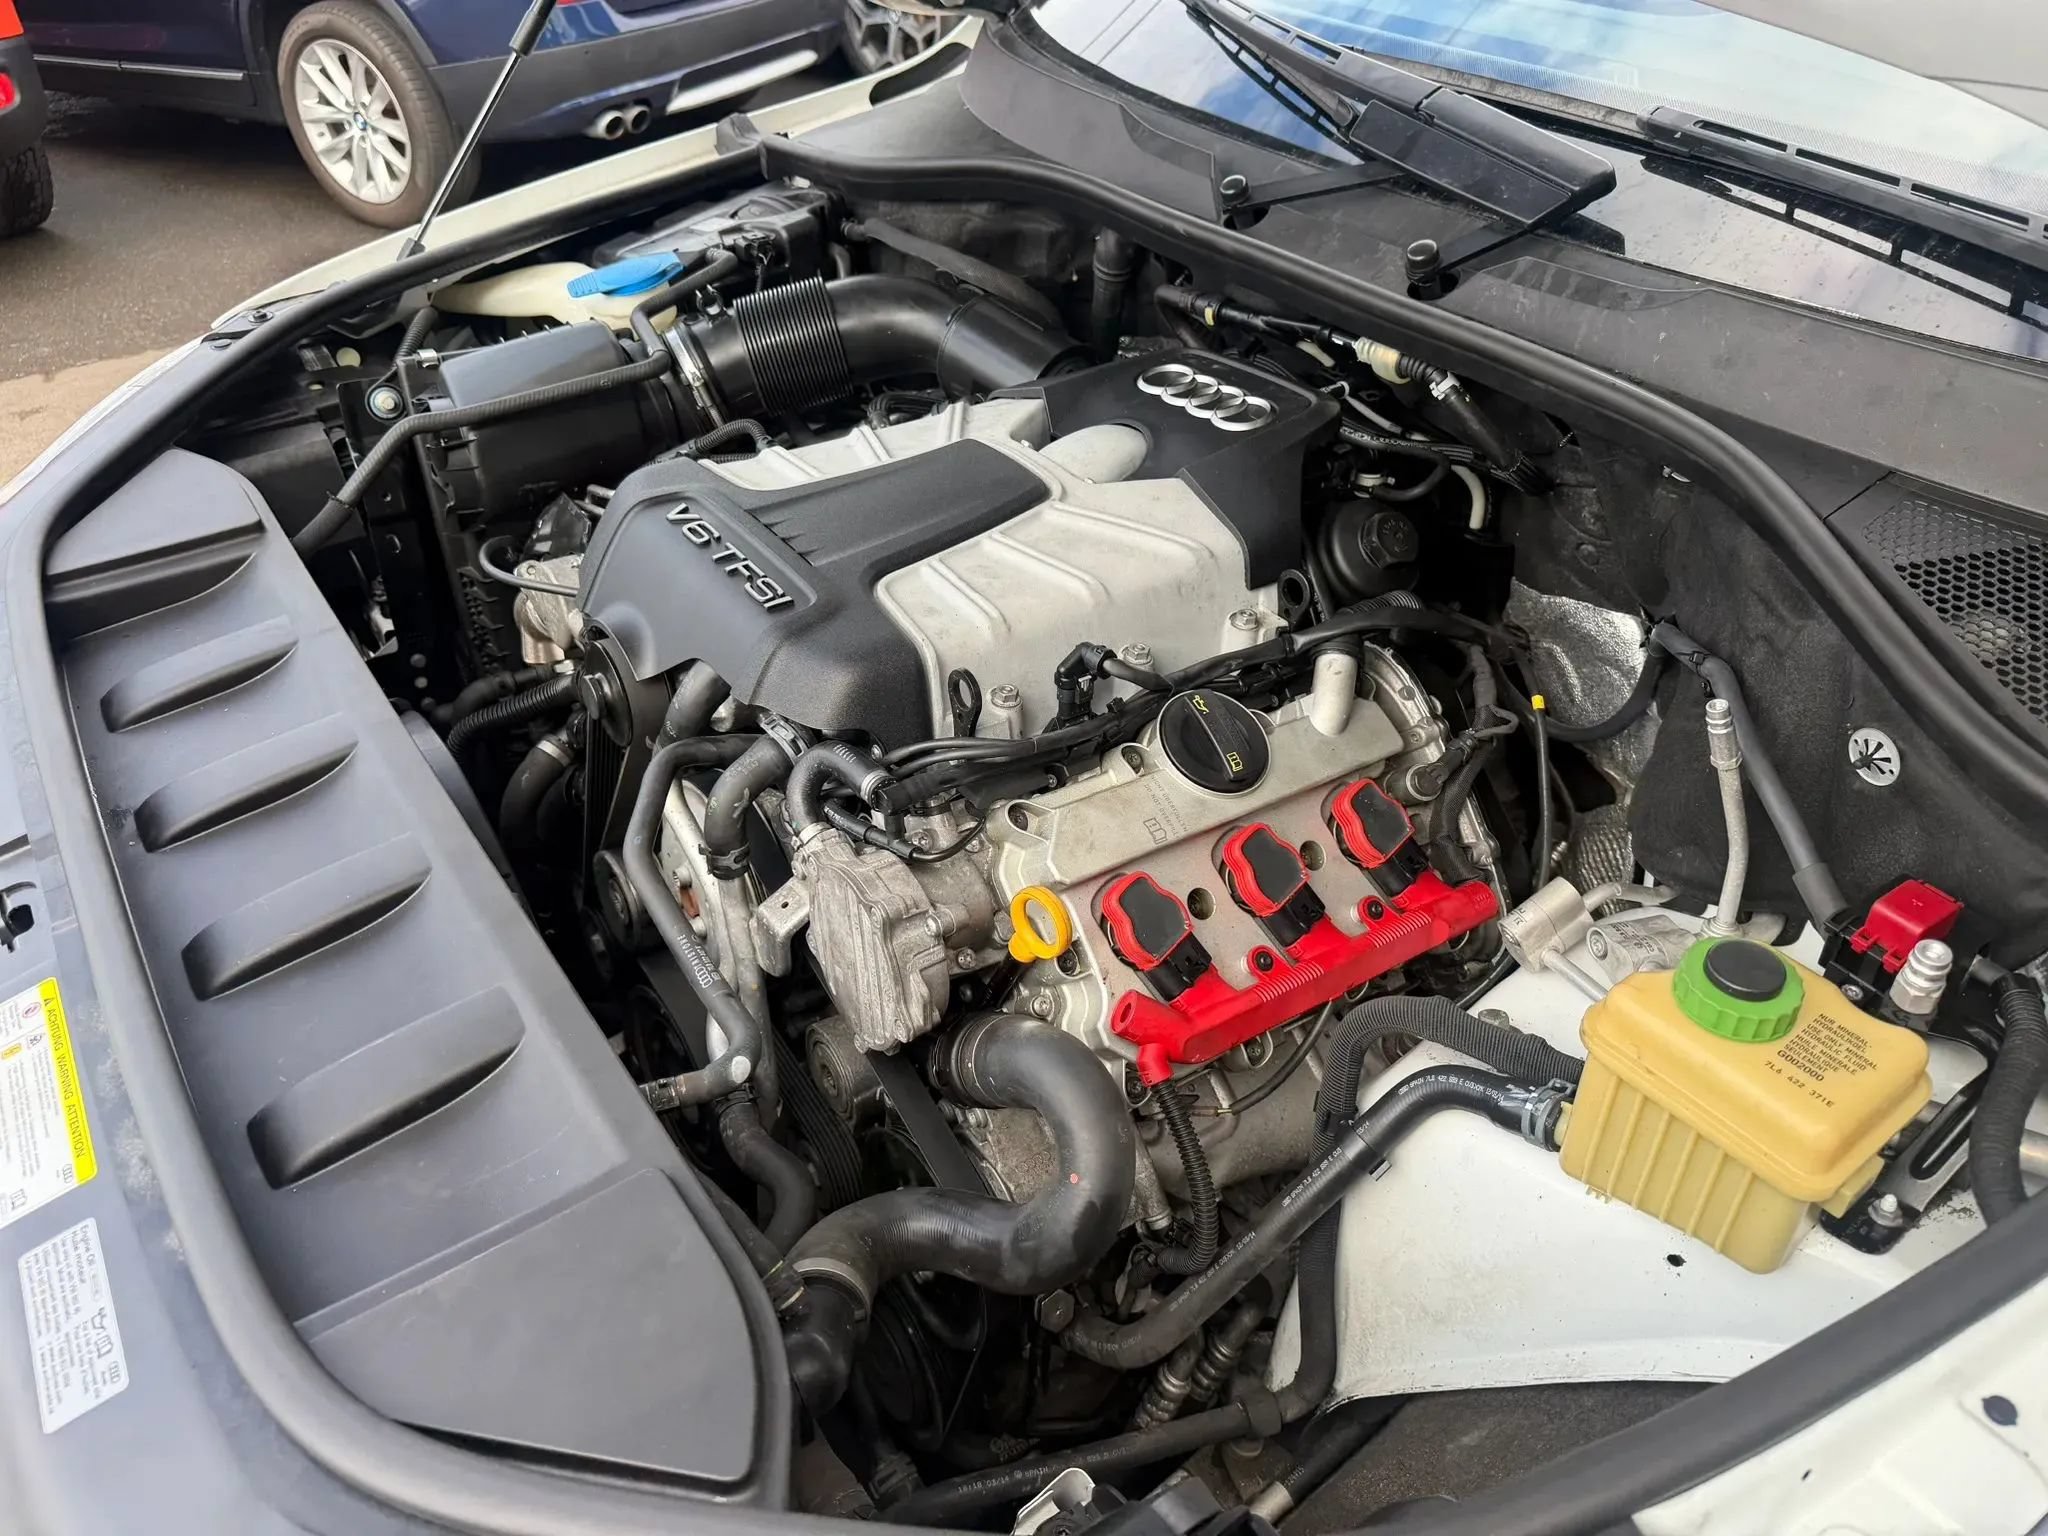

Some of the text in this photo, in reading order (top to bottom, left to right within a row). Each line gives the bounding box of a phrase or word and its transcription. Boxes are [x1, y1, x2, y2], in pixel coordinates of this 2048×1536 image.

[665, 502, 793, 611] V6 TFSI
[1812, 1018, 1868, 1053] HYDRAULIKOEL
[1818, 1013, 1836, 1026] NUR
[1783, 1044, 1828, 1074] SEULEMENT
[1789, 1039, 1840, 1073] HYDRAULIQUE
[1794, 1034, 1857, 1075] HUILE MINERALE
[1801, 1028, 1867, 1071] HYDRAULIC FLUID
[1806, 1024, 1879, 1070] USE ONLY MINERAL
[46, 1009, 85, 1158] ACHTUNG WARNING ATTENTION
[70, 1229, 87, 1285] Huile moteur
[79, 1223, 95, 1267] Engine Oil
